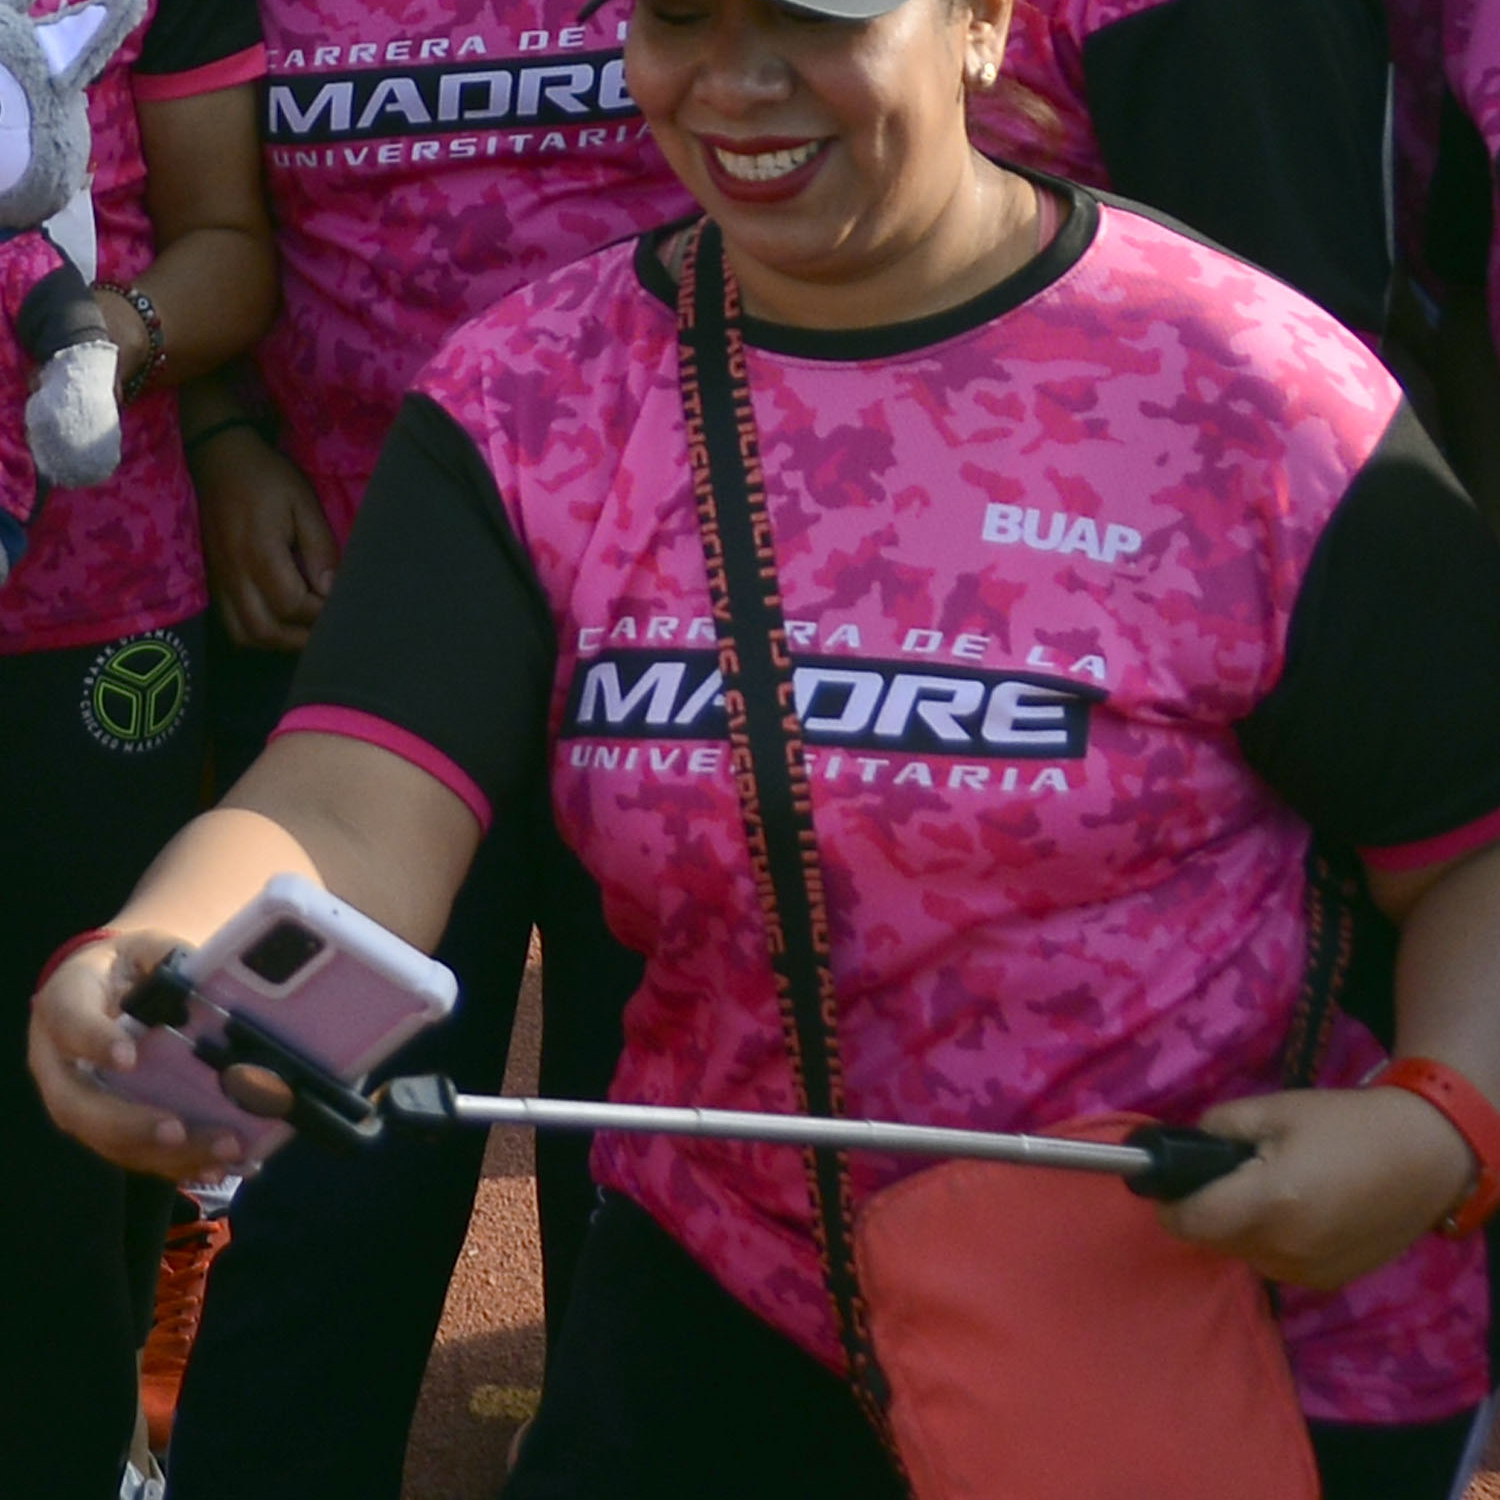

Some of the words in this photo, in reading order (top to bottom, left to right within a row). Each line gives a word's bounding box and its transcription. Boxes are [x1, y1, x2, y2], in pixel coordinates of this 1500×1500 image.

[518, 26, 590, 51] DE
[981, 501, 1143, 566] BUAP
[900, 629, 992, 660] DE
[1027, 645, 1108, 680] LA
